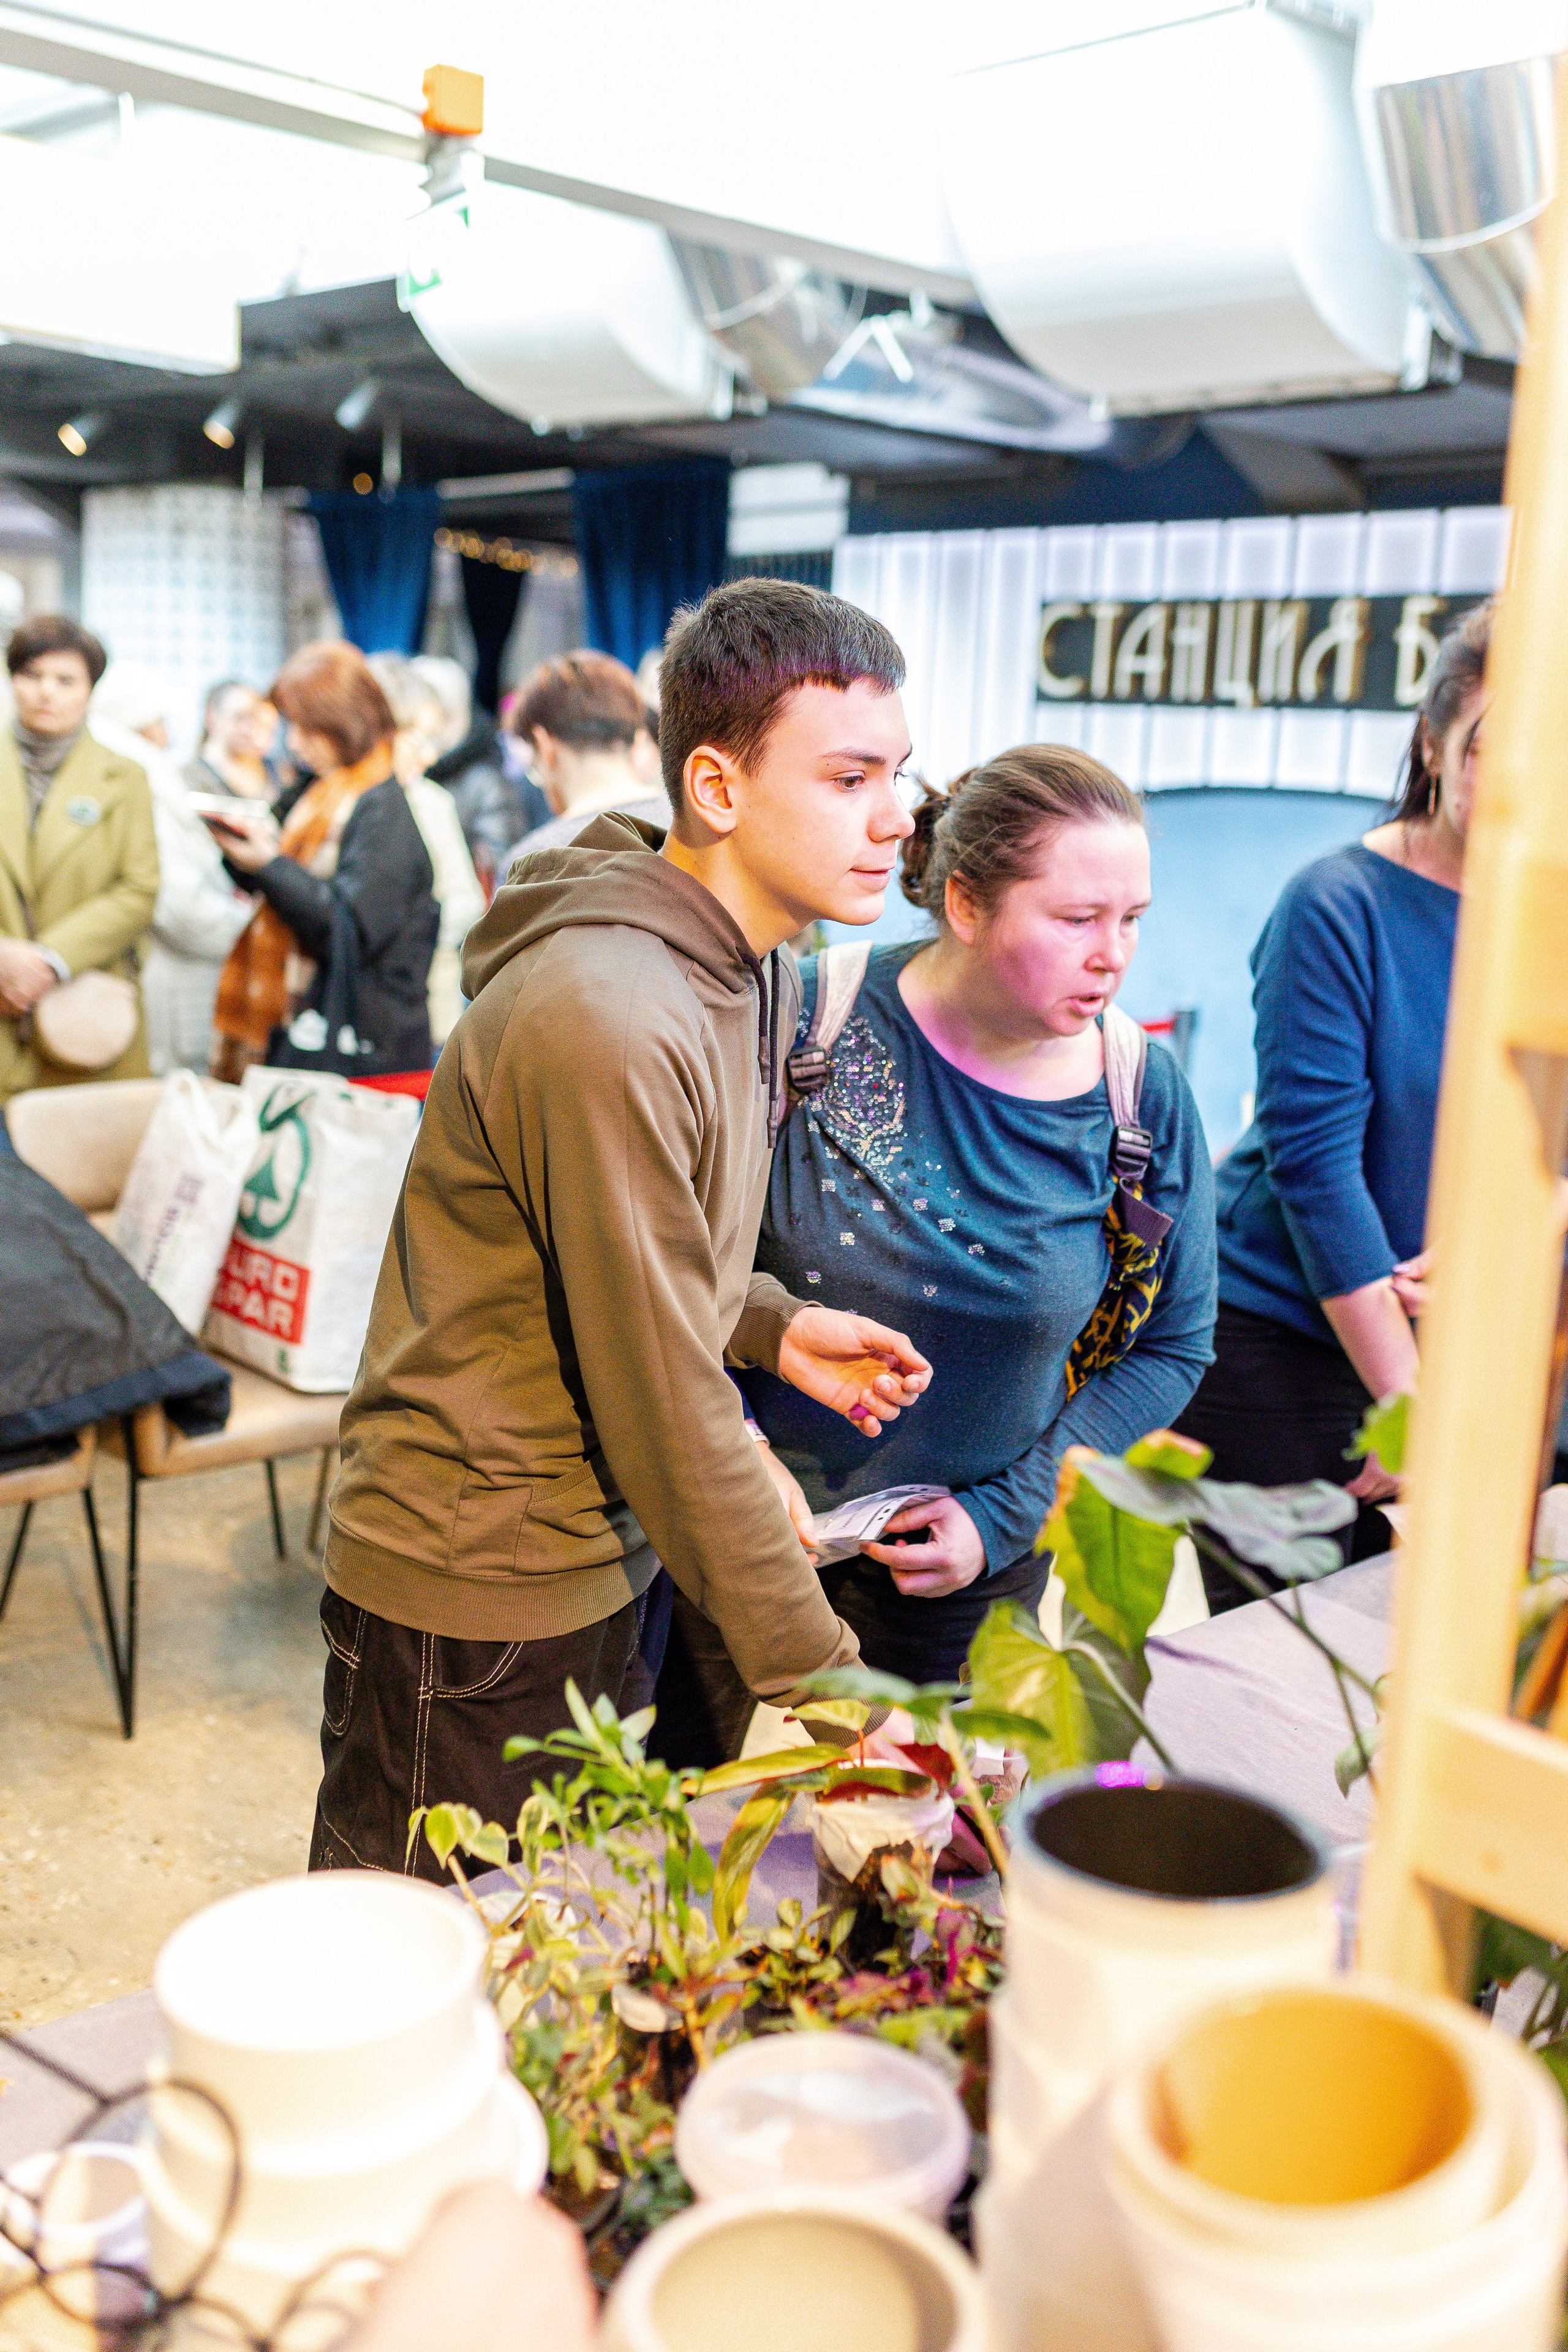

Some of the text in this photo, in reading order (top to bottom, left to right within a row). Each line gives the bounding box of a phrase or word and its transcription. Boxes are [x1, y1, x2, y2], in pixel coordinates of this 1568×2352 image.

[1394, 596, 1448, 705] Б
[225, 1246, 299, 1302] URO
[219, 1279, 294, 1338] PAR
